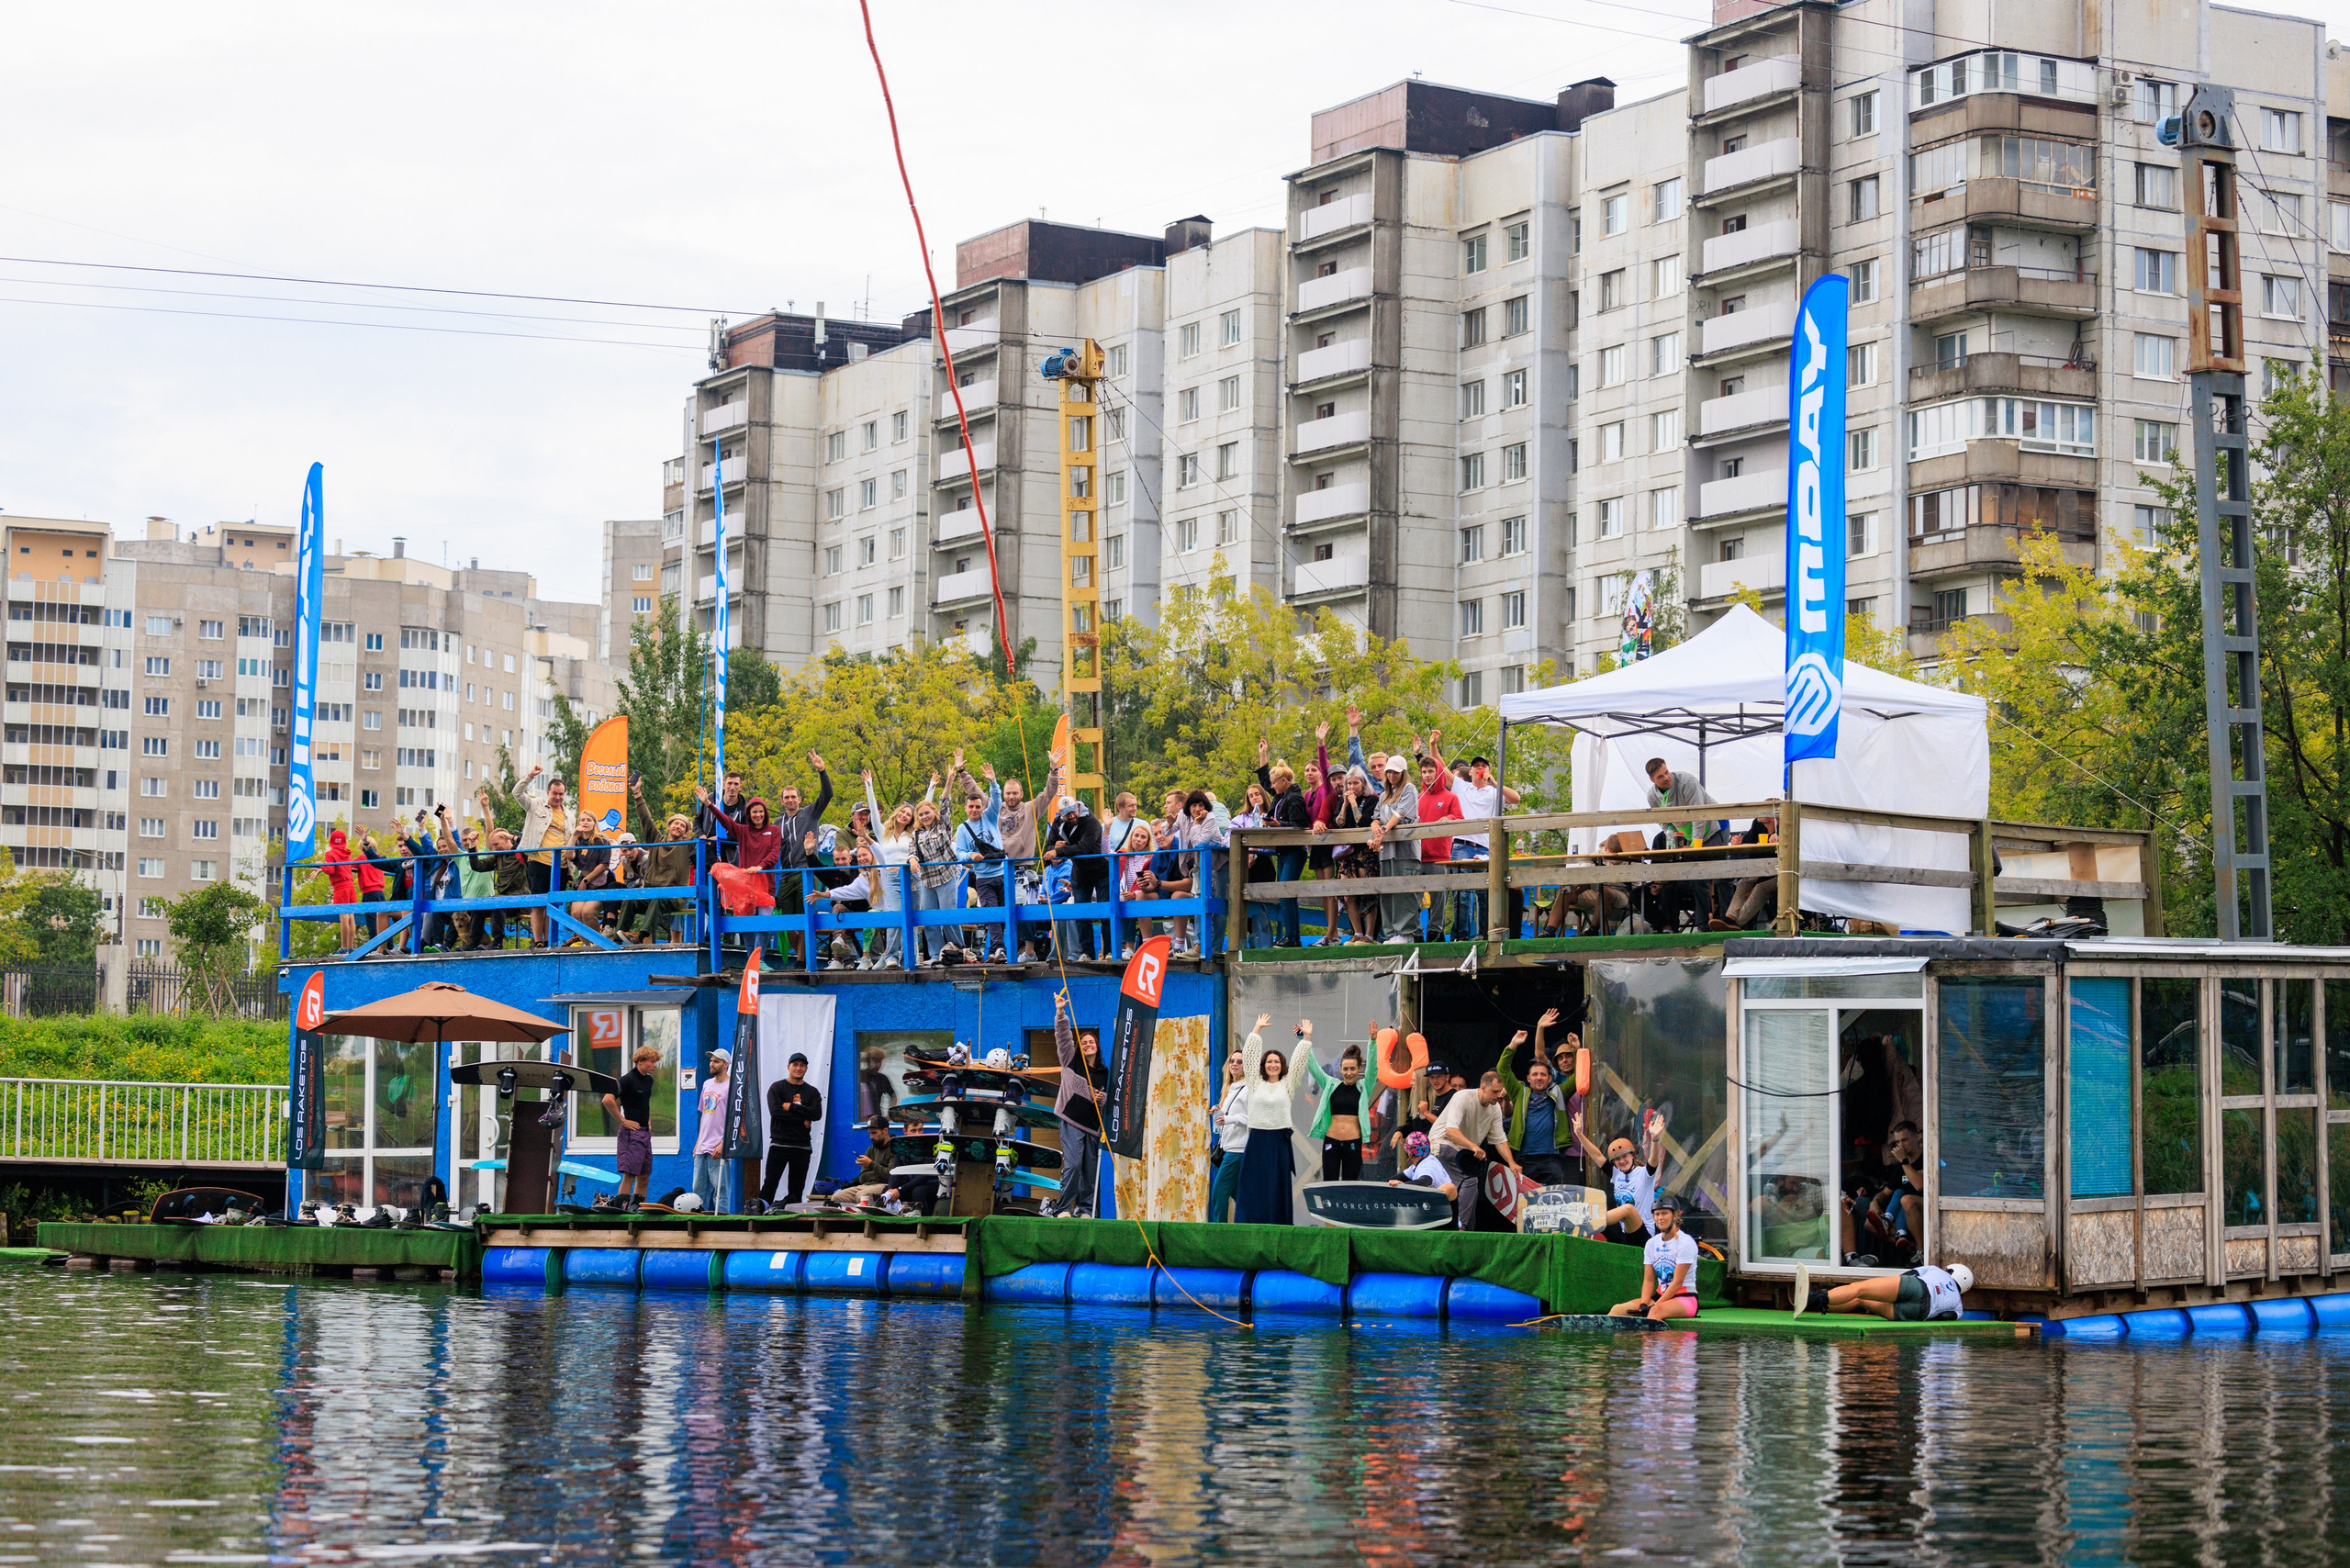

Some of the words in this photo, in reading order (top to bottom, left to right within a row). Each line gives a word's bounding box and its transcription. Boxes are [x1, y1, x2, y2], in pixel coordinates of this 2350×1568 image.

[587, 761, 626, 778] Веселый
[588, 778, 625, 793] водовоз
[1113, 1007, 1134, 1102] RAKETOS
[297, 1038, 307, 1123] RAKETOS
[729, 1116, 741, 1151] LOS
[1109, 1104, 1120, 1143] LOS
[295, 1126, 304, 1160] LOS
[1416, 1145, 1430, 1157] 33
[1335, 1202, 1371, 1211] FORCE
